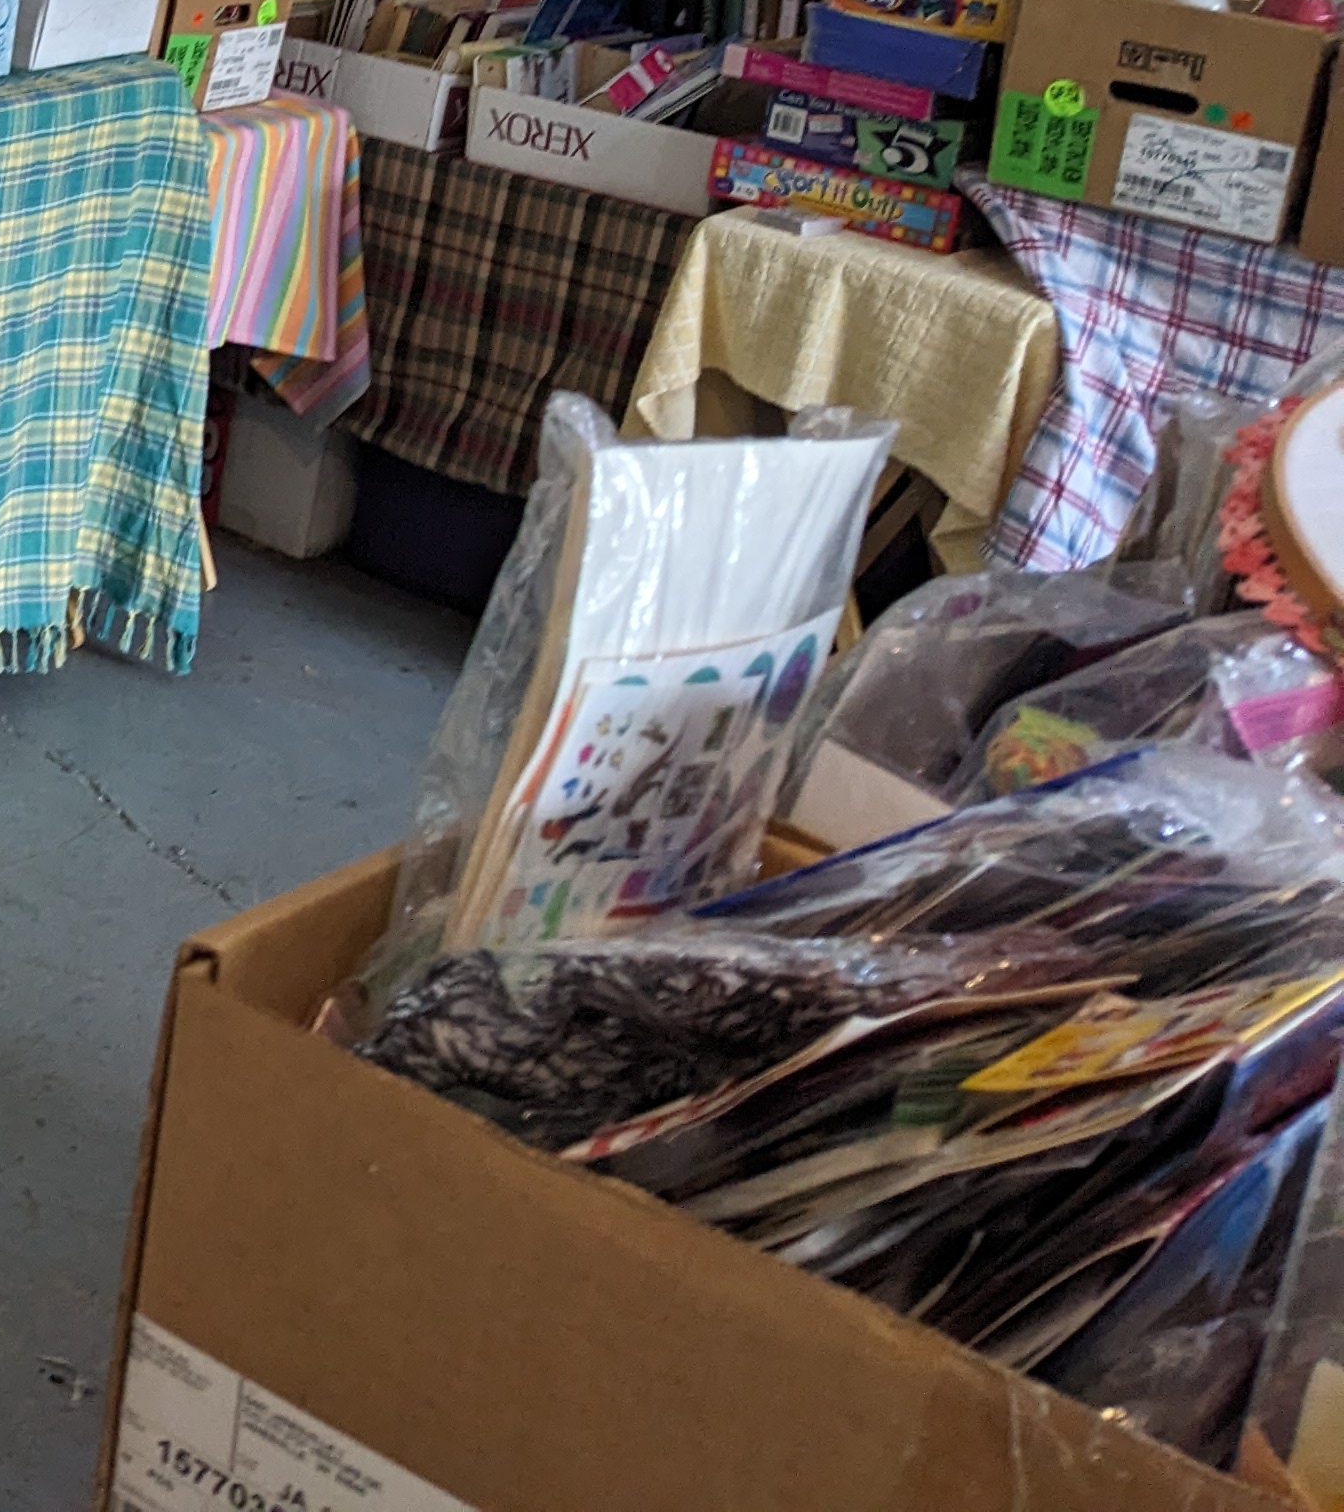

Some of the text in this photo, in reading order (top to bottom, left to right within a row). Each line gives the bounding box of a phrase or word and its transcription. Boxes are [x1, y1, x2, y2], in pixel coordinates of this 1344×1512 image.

[273, 59, 333, 98] XER
[488, 108, 596, 161] XEROX
[882, 125, 930, 175] 5
[157, 1438, 282, 1512] 15770
